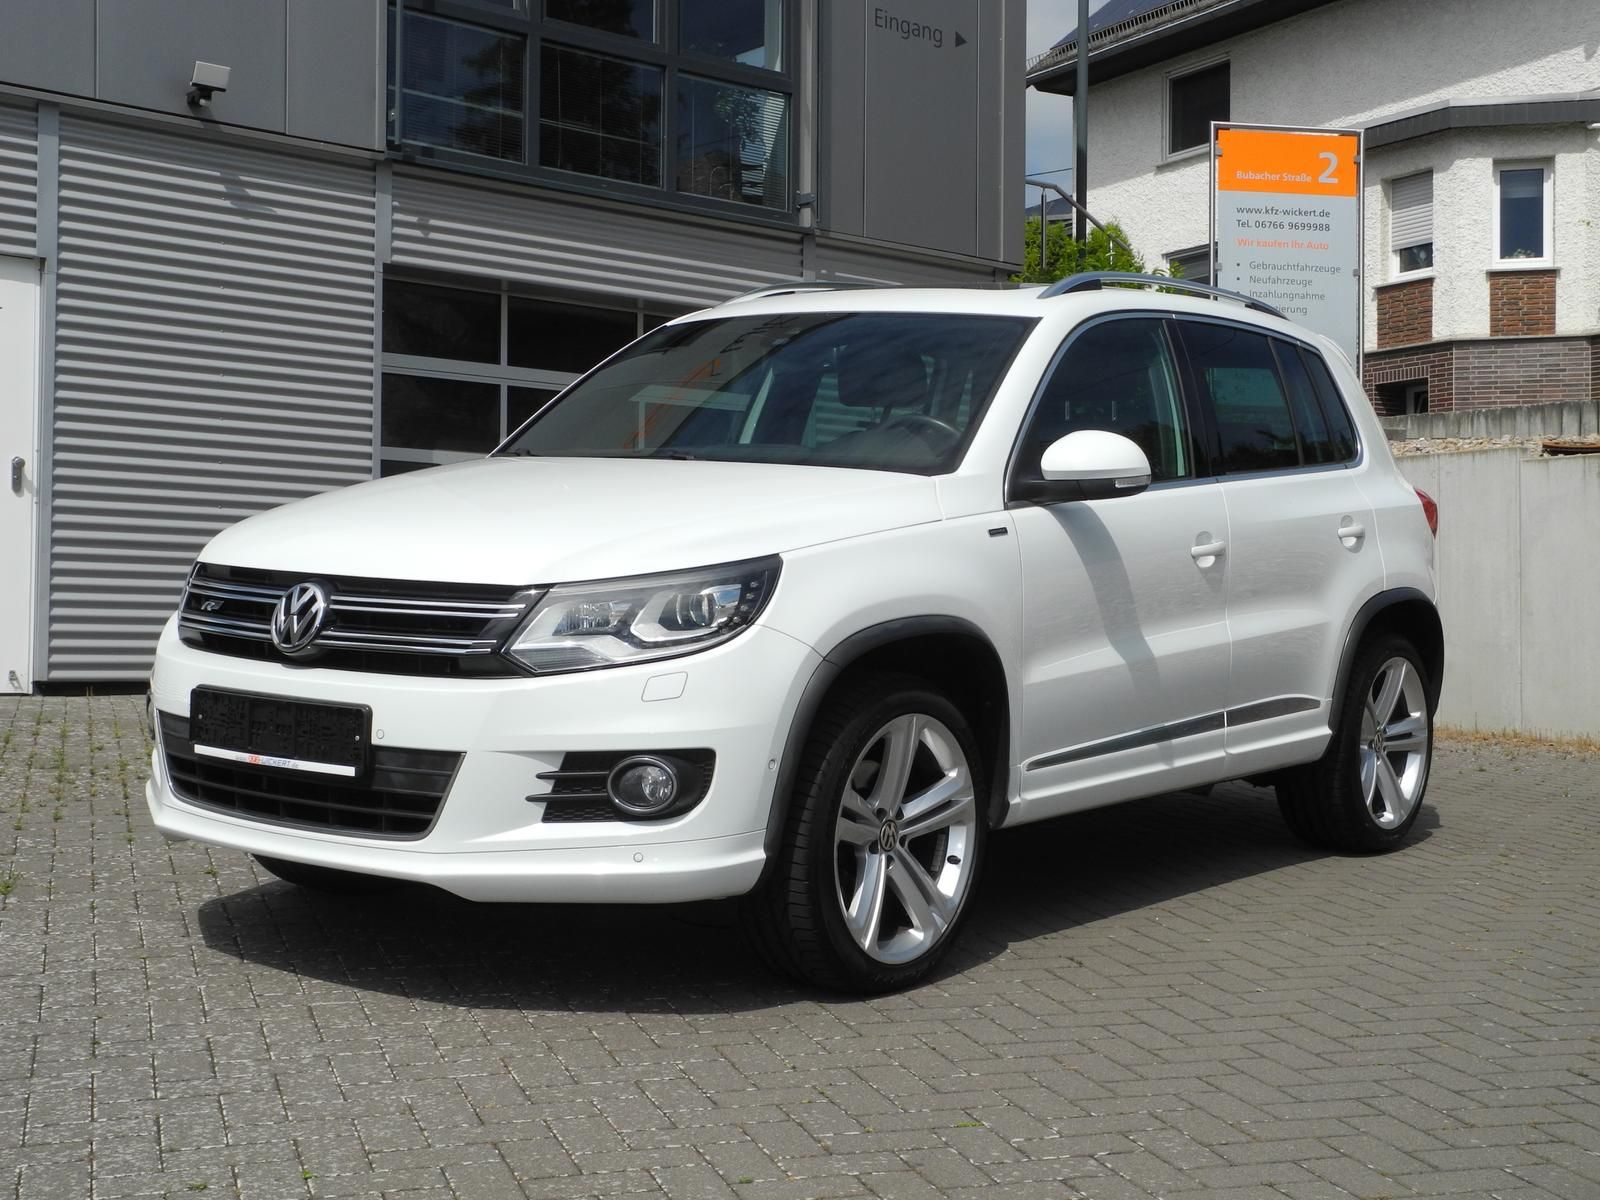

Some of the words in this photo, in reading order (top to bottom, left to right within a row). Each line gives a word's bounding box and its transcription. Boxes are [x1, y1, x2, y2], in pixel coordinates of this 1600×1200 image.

[874, 8, 943, 48] Eingang
[1236, 170, 1281, 181] Bubacher
[1282, 173, 1312, 183] Straße
[1317, 151, 1339, 184] 2
[1236, 206, 1331, 218] www.kfz-wickert.de
[1236, 219, 1252, 228] Tel.
[1254, 220, 1285, 230] 06766
[1288, 221, 1330, 232] 9699988
[1237, 238, 1254, 247] Wir
[1256, 238, 1289, 248] kaufen
[1291, 239, 1305, 249] Ihr
[1306, 240, 1329, 250] Auto
[1249, 261, 1341, 275] Gebrauchtfahrzeuge
[1249, 275, 1313, 287] Neufahrzeuge
[1249, 289, 1325, 301] Inzahlungnahme
